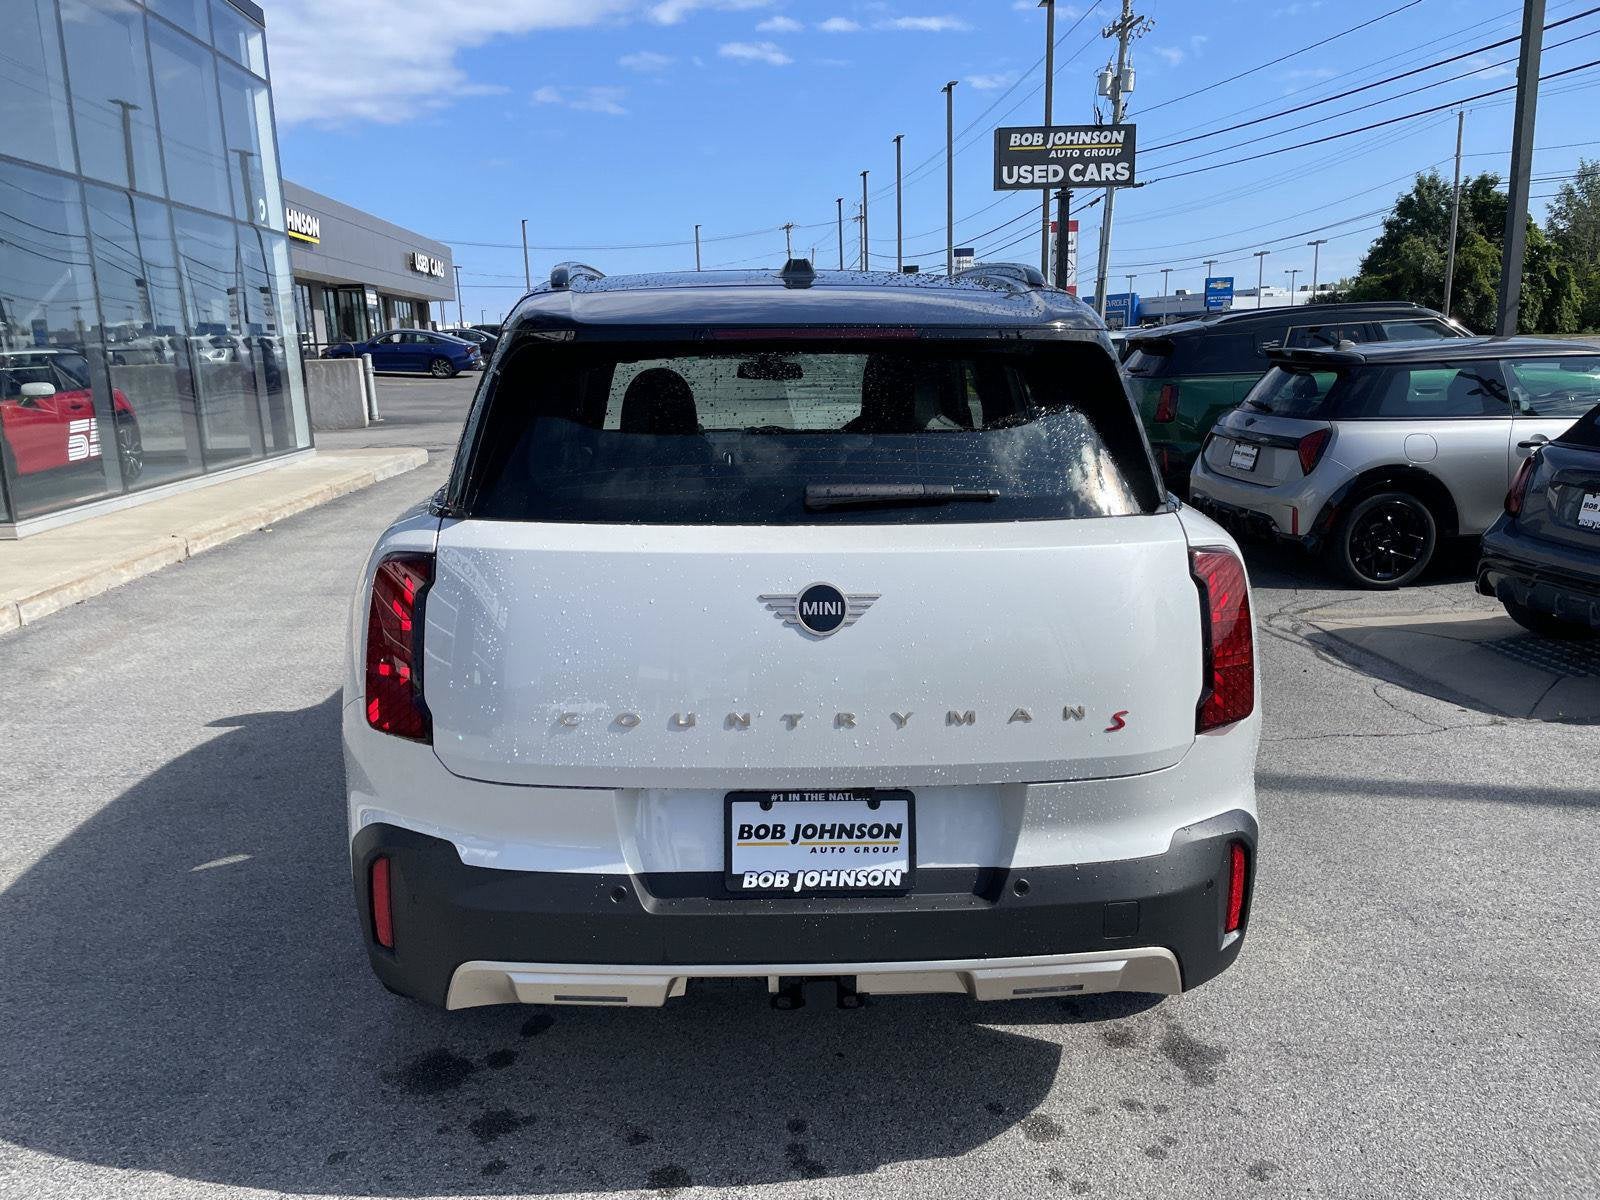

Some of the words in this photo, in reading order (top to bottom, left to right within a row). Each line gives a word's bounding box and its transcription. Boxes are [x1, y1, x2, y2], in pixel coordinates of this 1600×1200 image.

[1009, 132, 1044, 147] BOB
[1046, 130, 1125, 149] JOHNSON
[1049, 149, 1080, 158] AUTO
[1083, 148, 1122, 157] GROUP
[1002, 164, 1064, 185] USED
[1068, 162, 1130, 183] CARS
[414, 252, 430, 274] USED
[430, 258, 445, 278] CARS
[802, 600, 842, 616] MINI
[559, 705, 1085, 730] COUNTRYMAN
[771, 793, 784, 801] #1
[788, 793, 800, 801] IN
[803, 792, 826, 801] THE
[737, 823, 786, 840] BOB
[790, 822, 903, 844] JOHNSON
[810, 846, 846, 854] AUTO
[742, 871, 790, 888] BOB
[793, 870, 902, 892] JOHNSON
